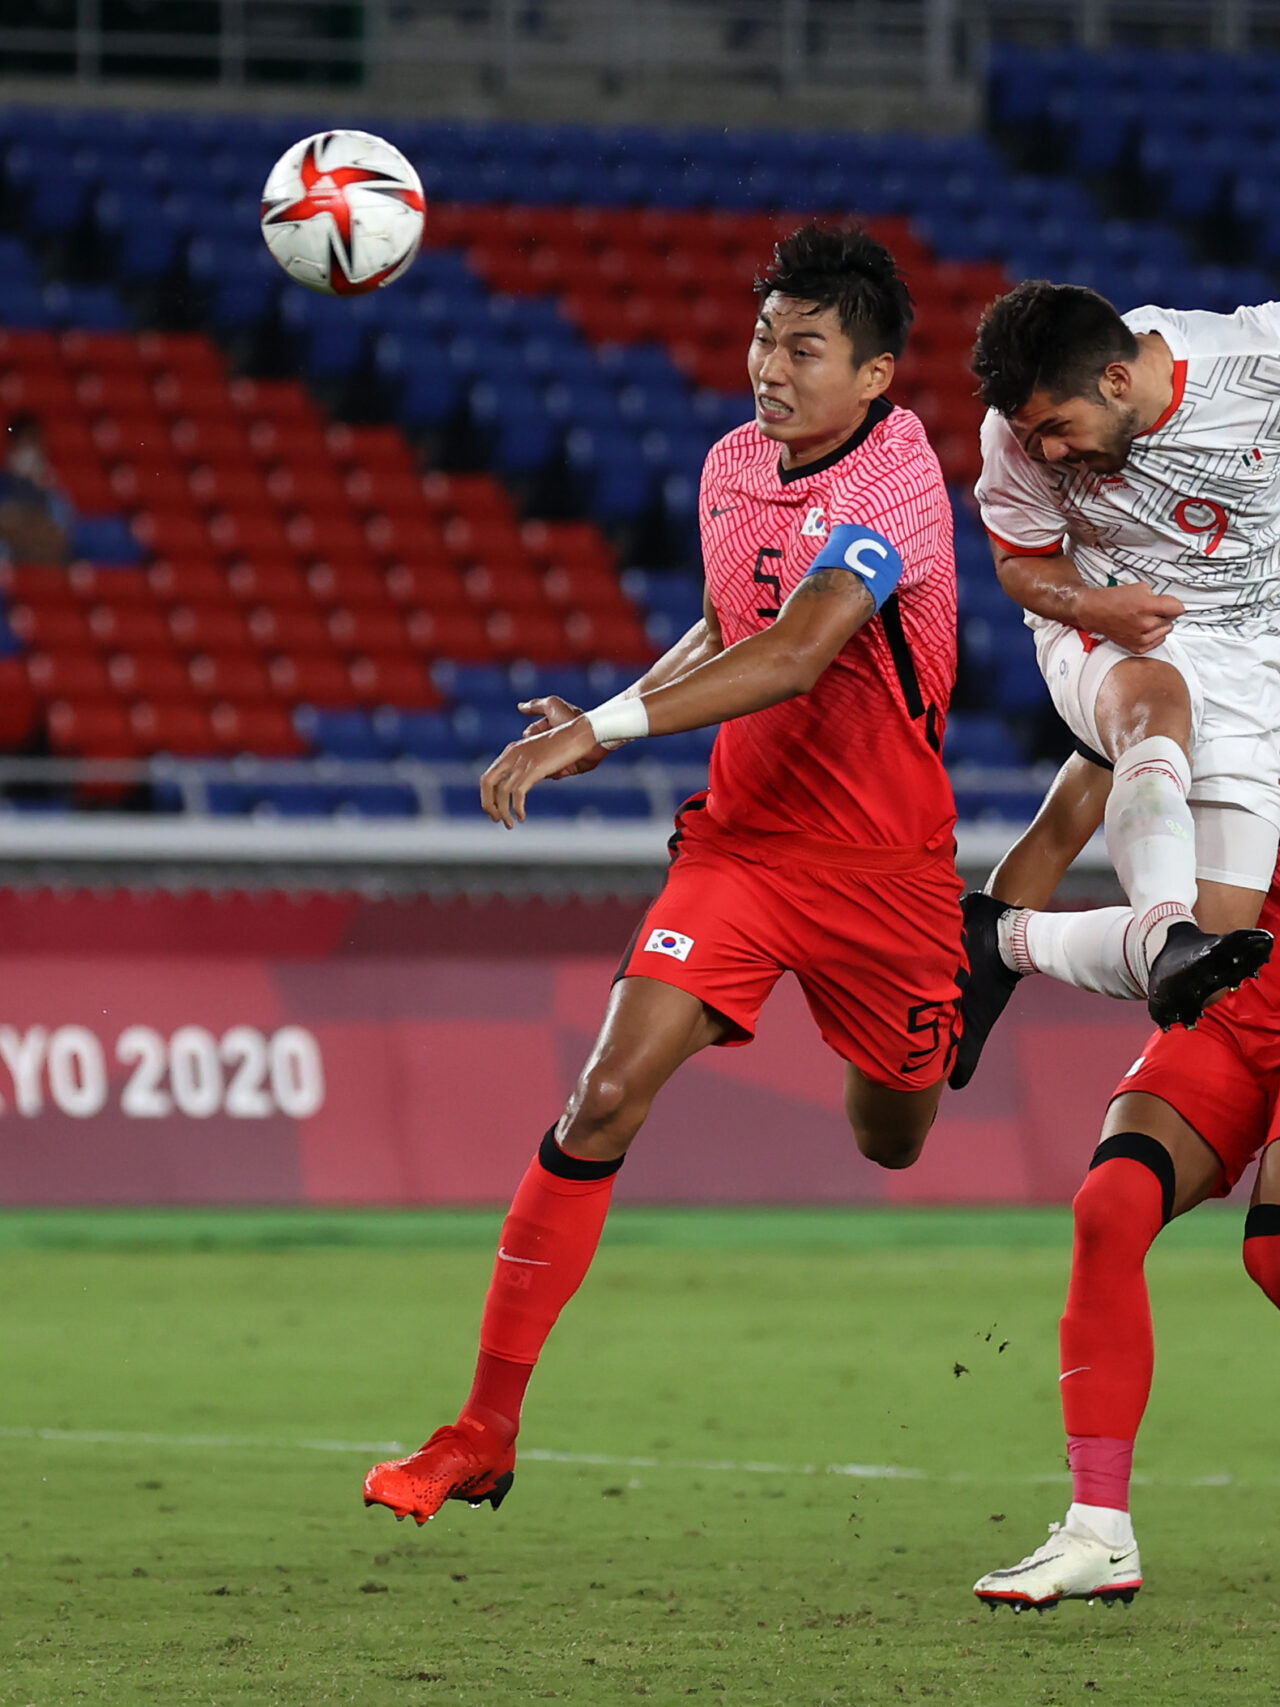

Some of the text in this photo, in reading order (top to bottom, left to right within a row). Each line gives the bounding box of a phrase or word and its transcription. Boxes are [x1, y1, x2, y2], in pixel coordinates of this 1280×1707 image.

[1175, 498, 1228, 556] 9
[754, 547, 782, 618] 5
[844, 538, 888, 579] C
[908, 1001, 943, 1058] 5
[0, 1024, 325, 1118] YO 2020
